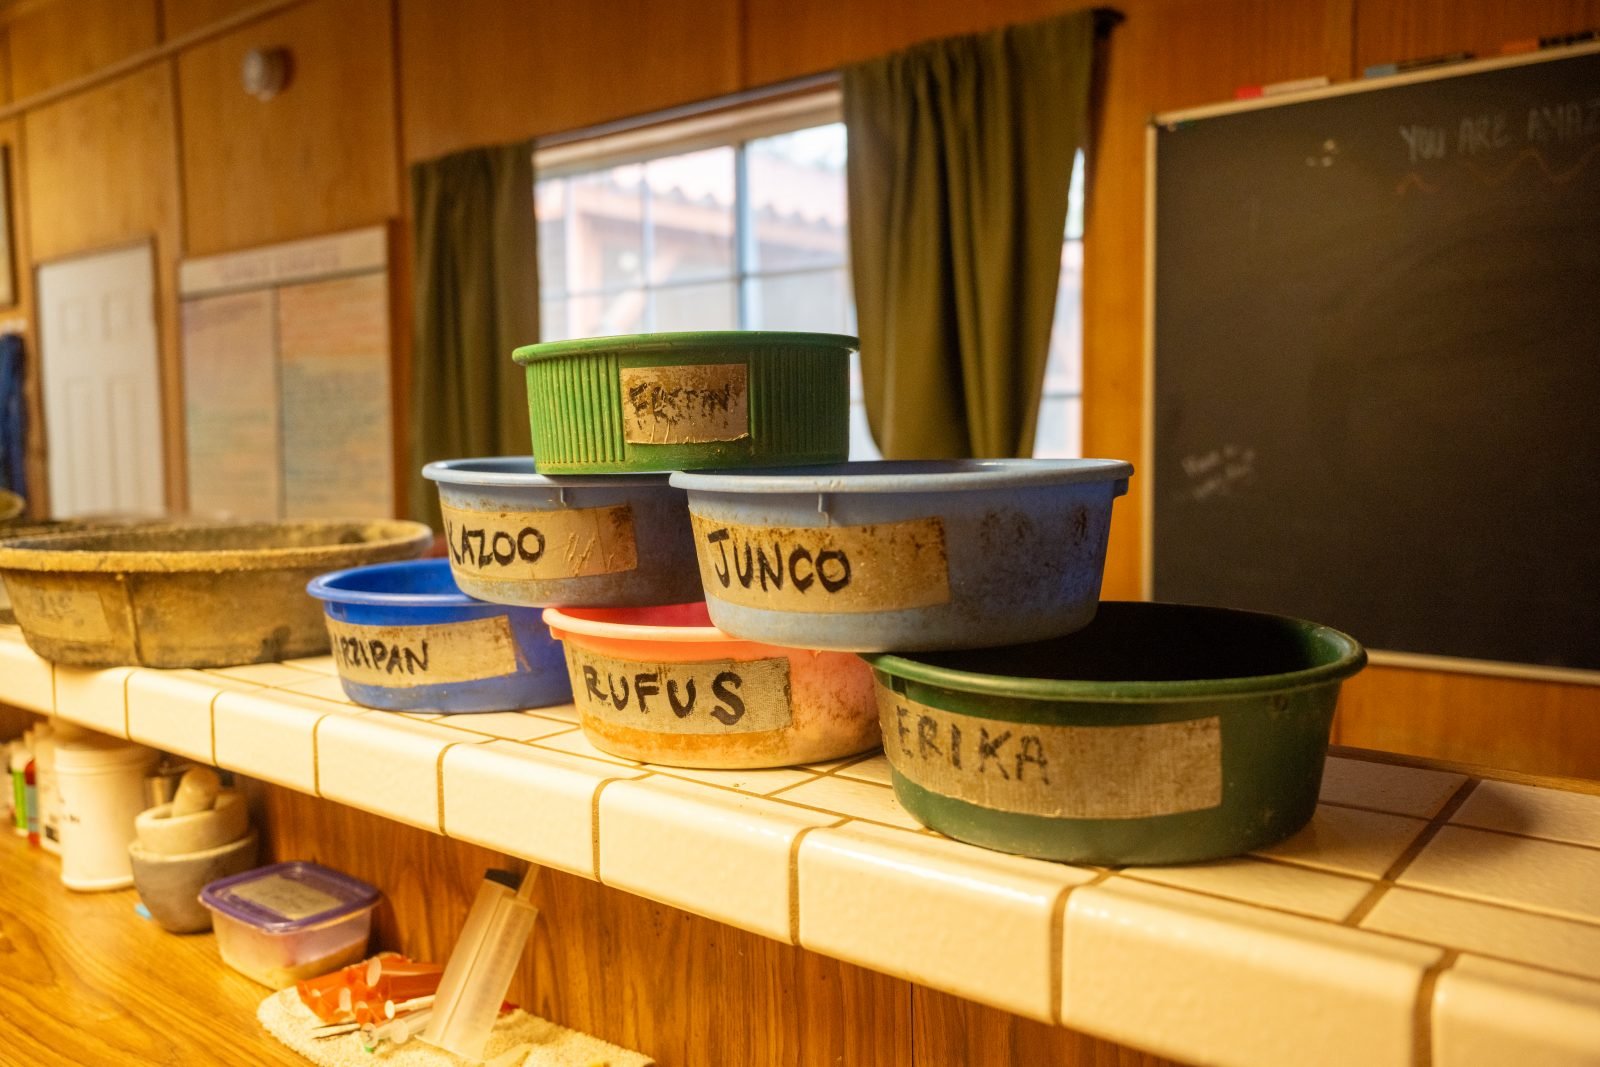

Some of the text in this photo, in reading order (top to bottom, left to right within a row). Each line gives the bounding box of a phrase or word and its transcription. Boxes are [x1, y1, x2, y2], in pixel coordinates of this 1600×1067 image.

[1527, 97, 1600, 144] AMA
[446, 518, 546, 569] KAZOO
[707, 528, 851, 594] JUNCO
[583, 665, 745, 726] RUFUS
[897, 705, 1049, 785] ERIKA
